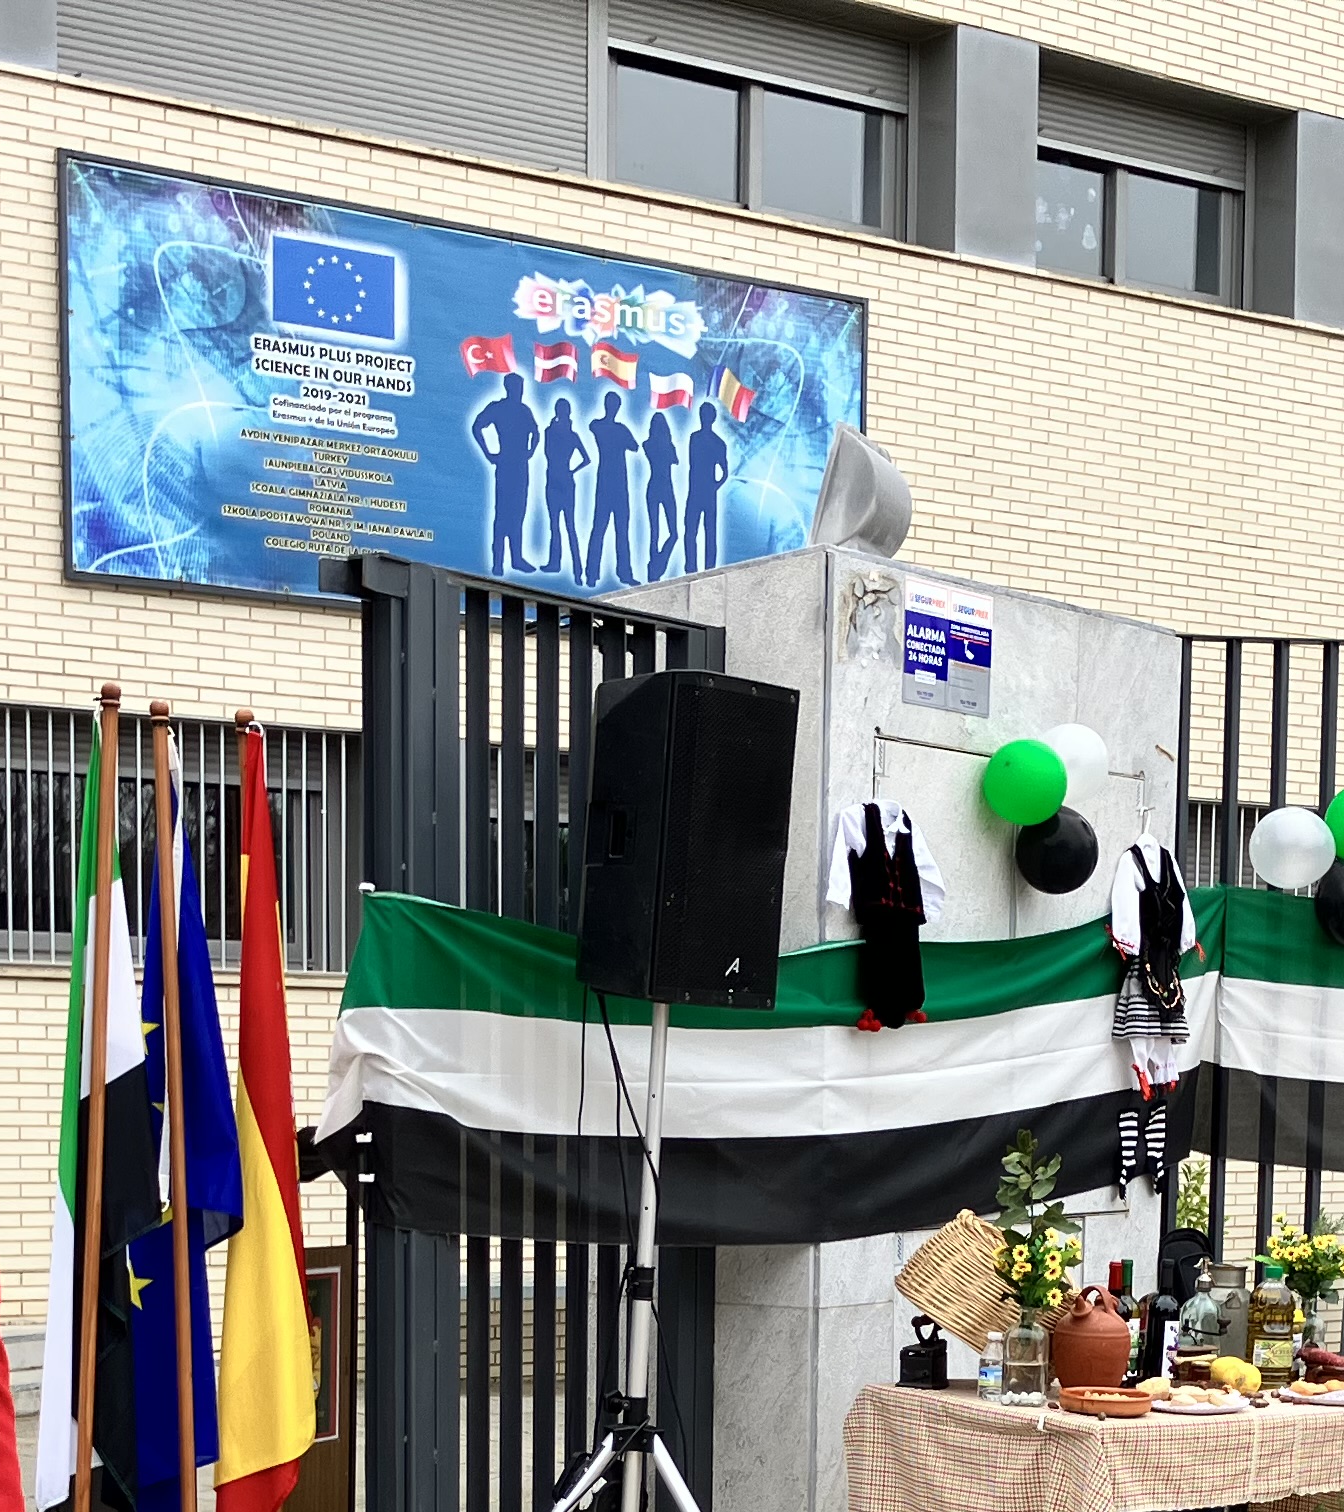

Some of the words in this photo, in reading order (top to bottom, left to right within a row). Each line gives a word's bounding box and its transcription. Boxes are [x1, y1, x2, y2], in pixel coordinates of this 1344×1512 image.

[254, 337, 315, 358] ERASMUS
[319, 348, 351, 363] PLUS
[356, 353, 413, 373] PROJECT
[255, 358, 310, 378] SCIENCE
[315, 367, 329, 380] IN
[333, 370, 362, 386] OUR
[366, 374, 412, 393] HANDS
[302, 386, 366, 406] 2019-2021
[272, 397, 326, 413] Cofinanciado
[328, 407, 342, 416] por
[344, 408, 351, 416] el
[353, 410, 393, 423] programa
[272, 410, 306, 423] Erasmus
[315, 416, 325, 425] de
[327, 418, 335, 427] la
[337, 419, 360, 430] Unión
[362, 423, 396, 436] Europea
[241, 428, 270, 441] AYDIN
[272, 434, 324, 448] YENIPAZAR
[326, 440, 361, 452] MERKEZ
[363, 446, 418, 461] ORTAOKULU
[313, 452, 349, 465] TURKEY
[264, 459, 337, 476] JAUNPIEBALGAS
[339, 468, 393, 483] VIDUSSKOLA
[314, 478, 347, 490] LATVIA
[252, 483, 286, 495] SCOALA
[289, 487, 345, 503] GIMNAZIALA
[370, 498, 406, 511] HUDESTI
[309, 503, 352, 516] ROMANIA
[222, 505, 257, 517] SZKOLA
[259, 511, 326, 526] PODSTAWOWA
[393, 527, 425, 538] PAWLA
[312, 529, 350, 542] POLAND
[265, 538, 306, 550] COLEGIO
[308, 543, 332, 552] RUTA
[334, 546, 346, 554] DE
[906, 624, 946, 644] ALARMA
[906, 639, 946, 656] CONECTADA
[908, 651, 918, 661] 24
[918, 653, 943, 667] HORAS
